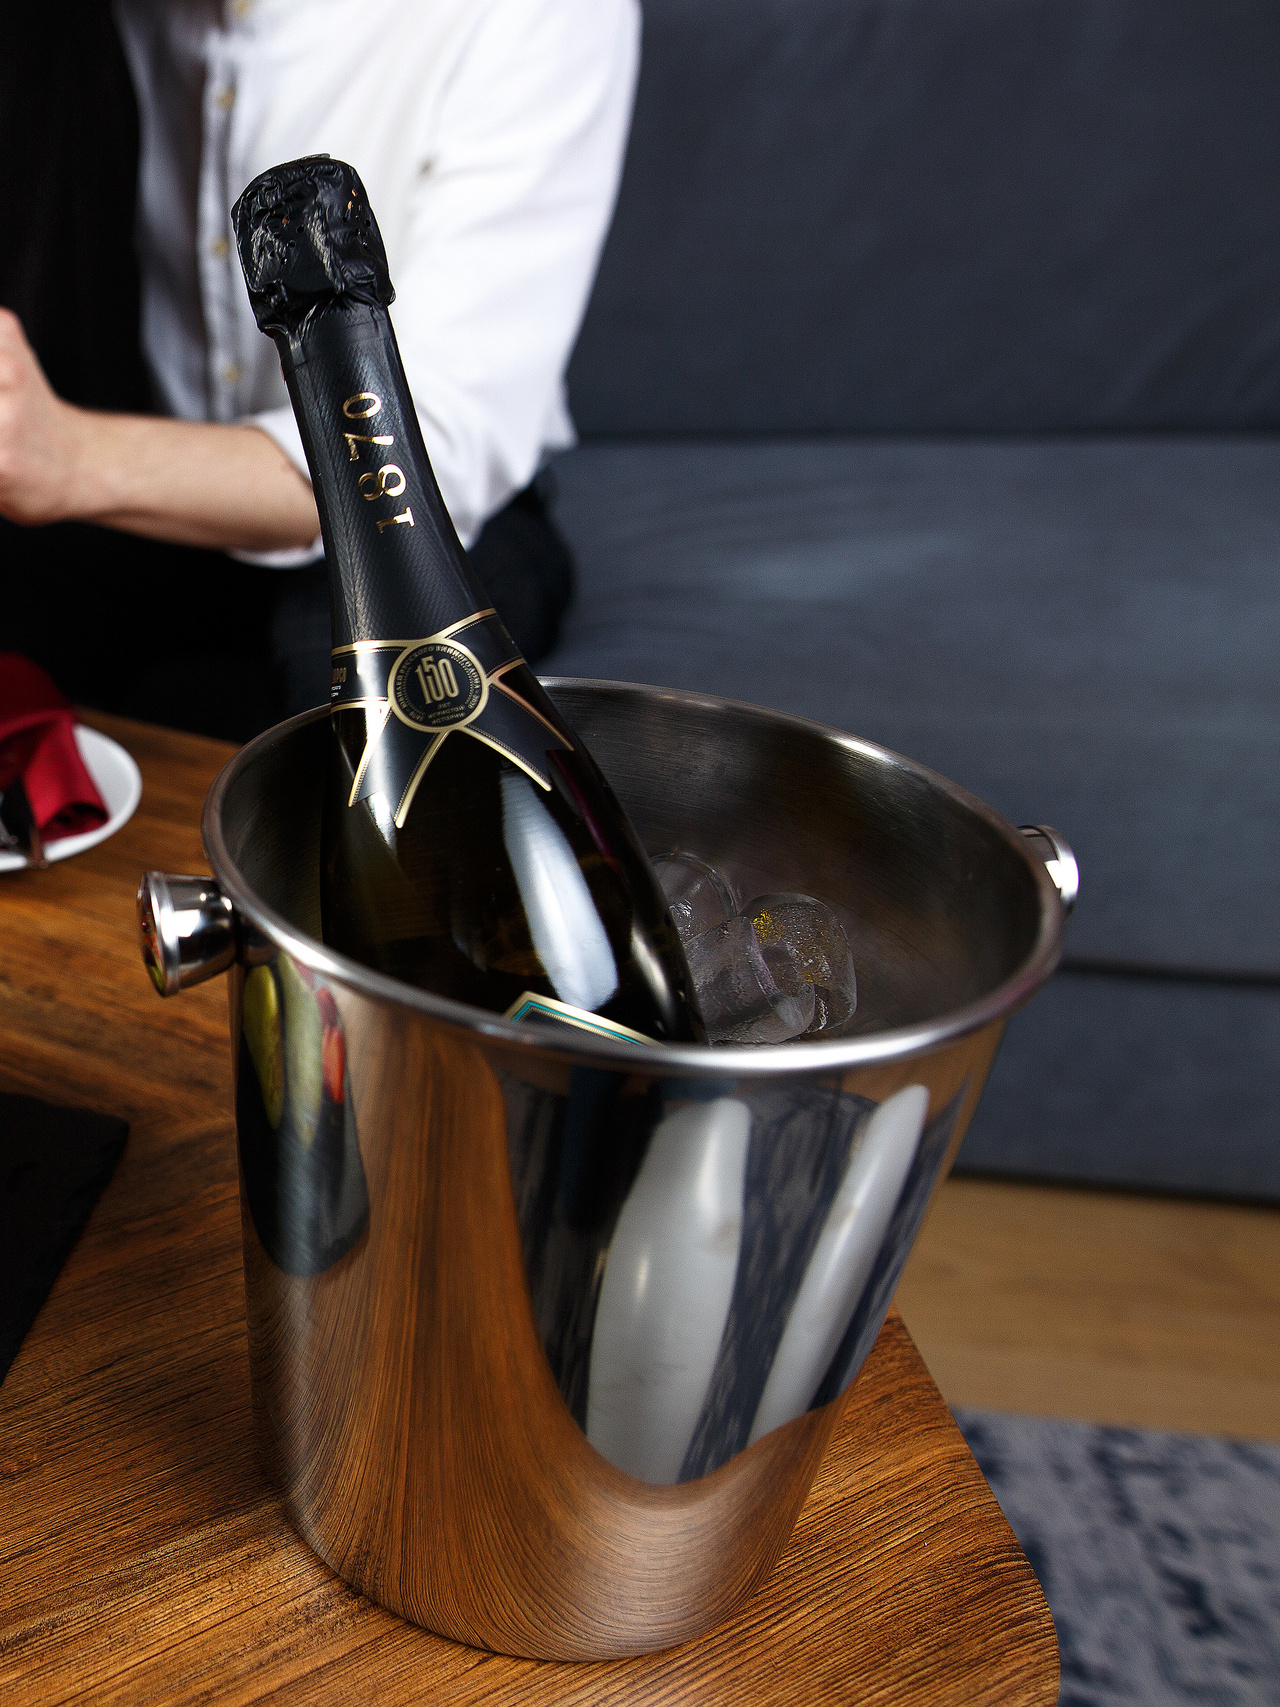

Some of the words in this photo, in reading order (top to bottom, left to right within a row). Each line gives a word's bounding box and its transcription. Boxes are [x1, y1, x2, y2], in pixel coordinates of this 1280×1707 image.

[342, 391, 415, 534] 1870
[415, 655, 460, 705] 150
[435, 646, 473, 668] ВИННОГО
